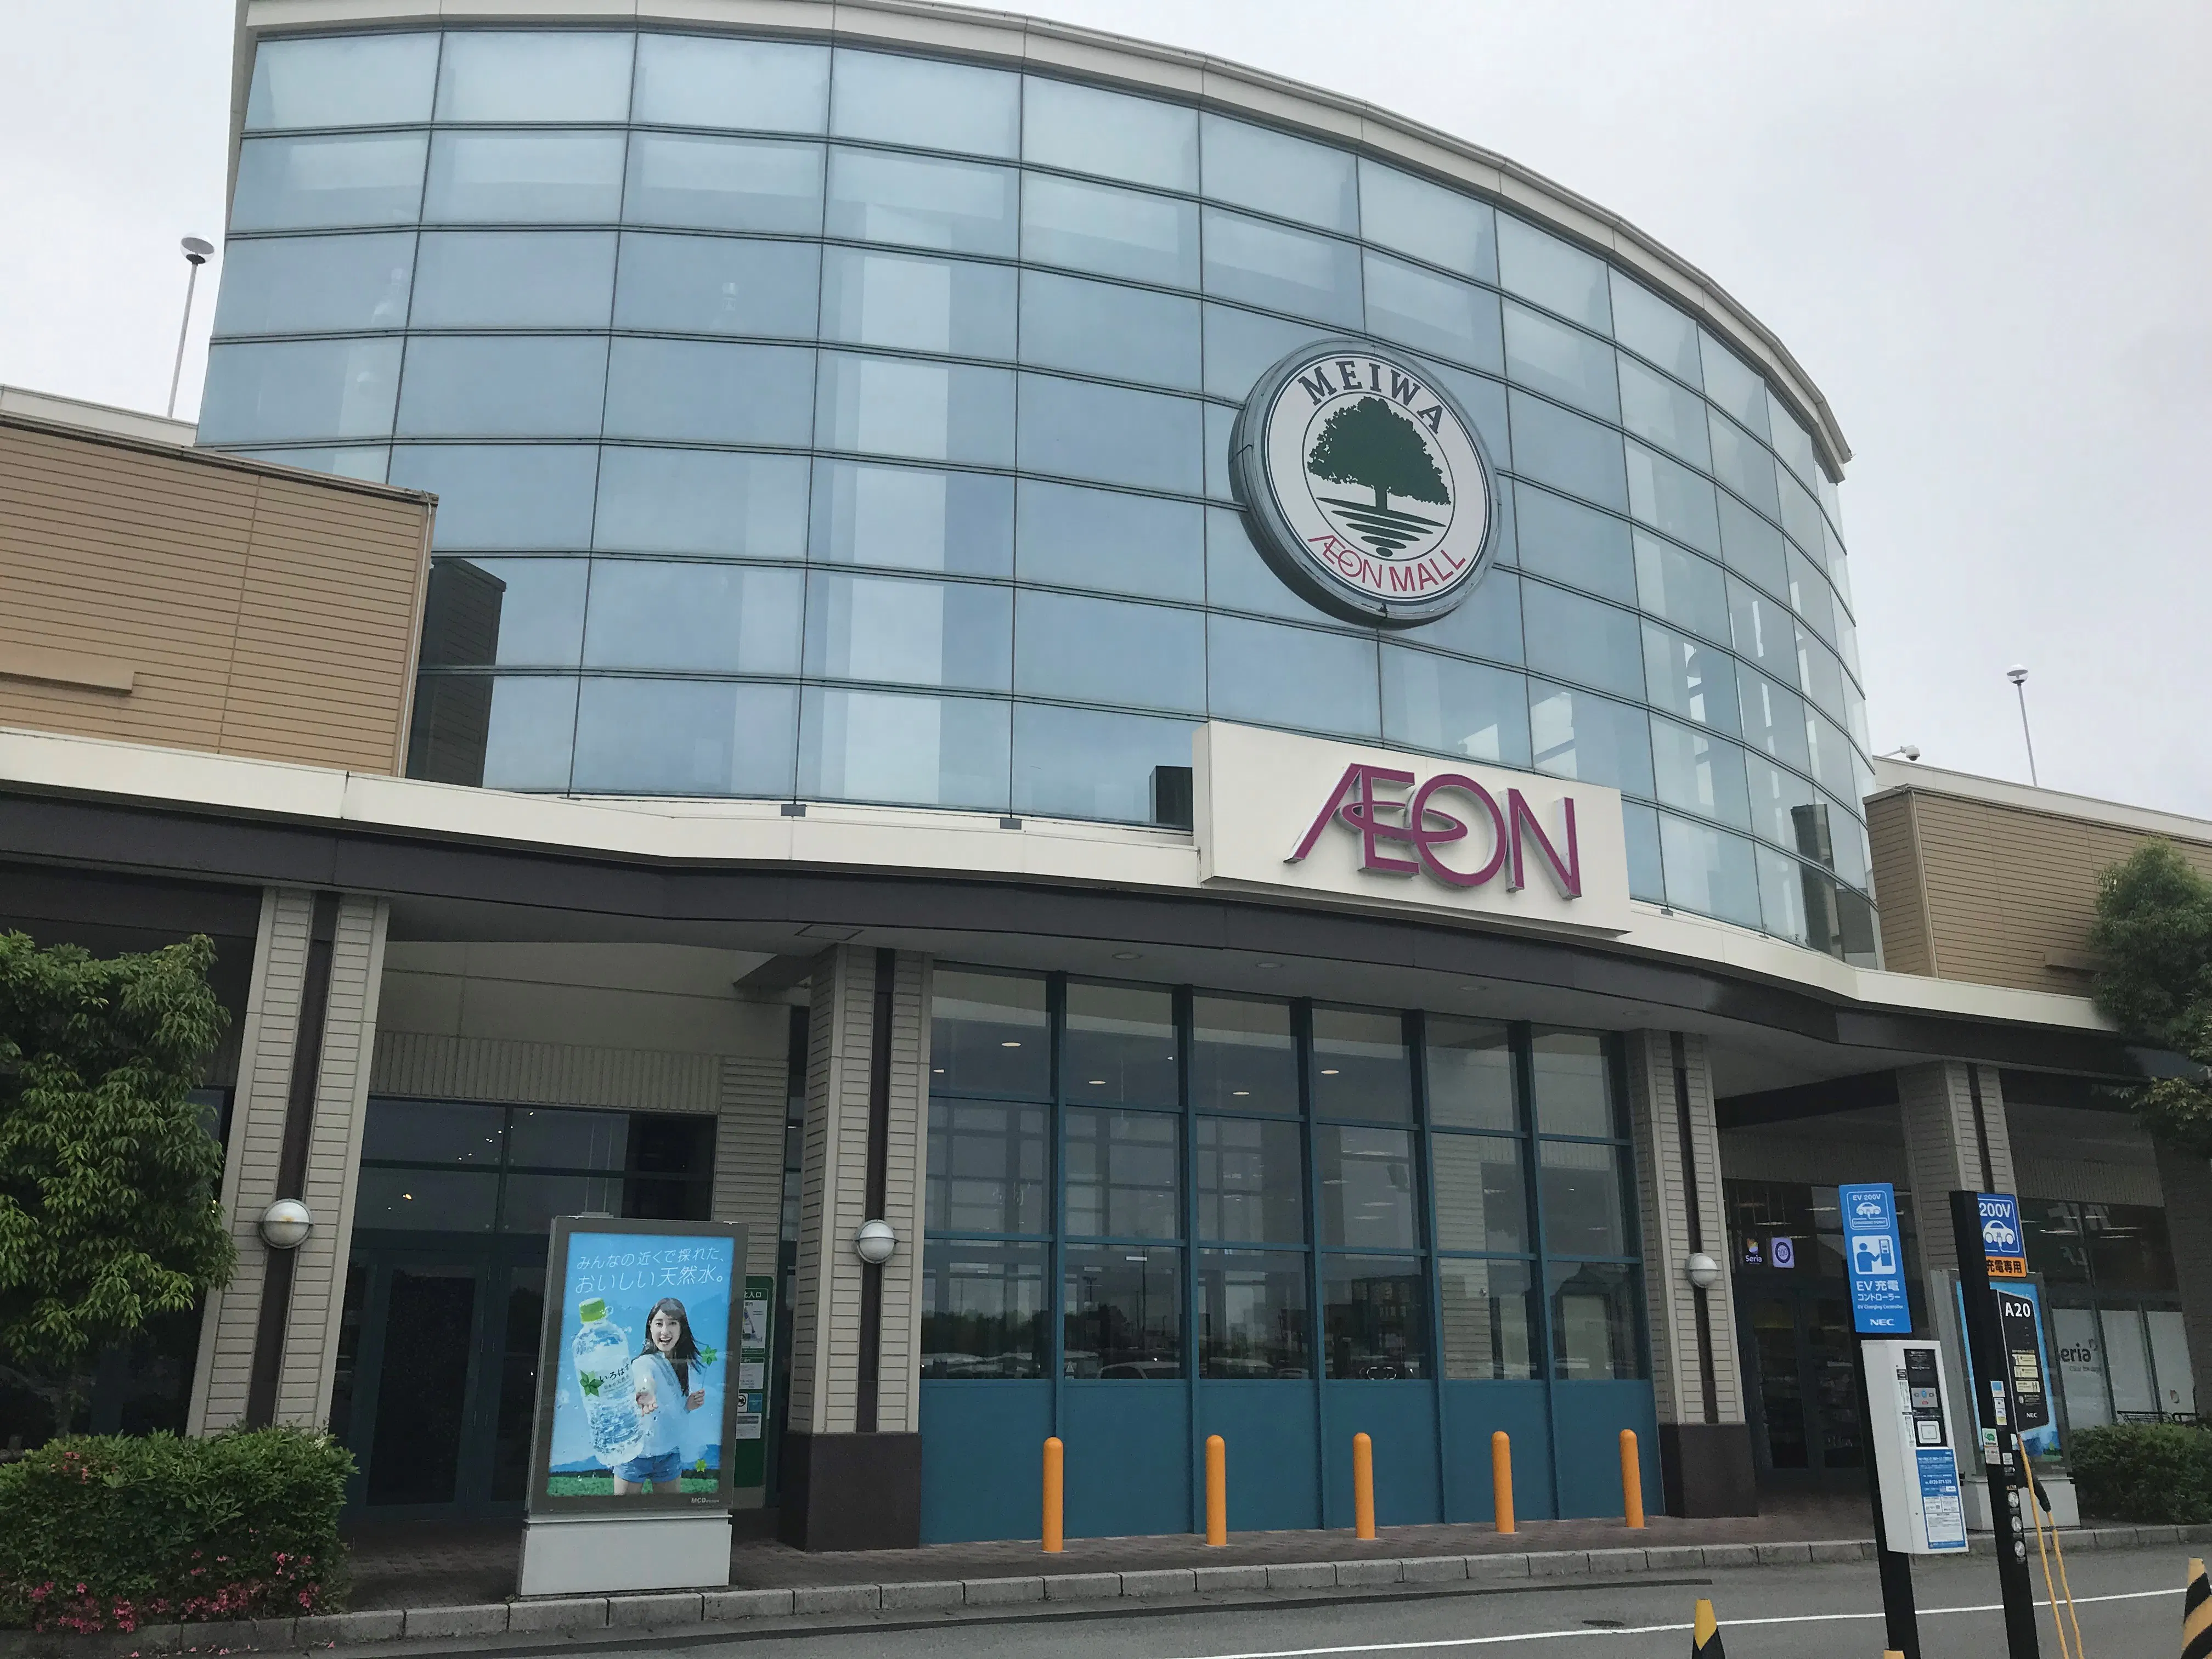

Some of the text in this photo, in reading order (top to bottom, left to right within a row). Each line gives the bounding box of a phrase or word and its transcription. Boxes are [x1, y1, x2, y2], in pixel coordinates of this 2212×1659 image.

[1297, 360, 1443, 435] MEIWA
[1389, 550, 1466, 592] MALL
[1979, 1203, 2011, 1218] 200V
[577, 1247, 724, 1269] みんなの近くで採れた、
[1987, 1260, 2022, 1273] 充電専用
[575, 1264, 723, 1293] おいしい天然水。
[1857, 1280, 1899, 1291] EV 充電
[1858, 1293, 1900, 1301] コントローラー
[2005, 1302, 2030, 1317] A20
[2061, 1342, 2091, 1362] eria
